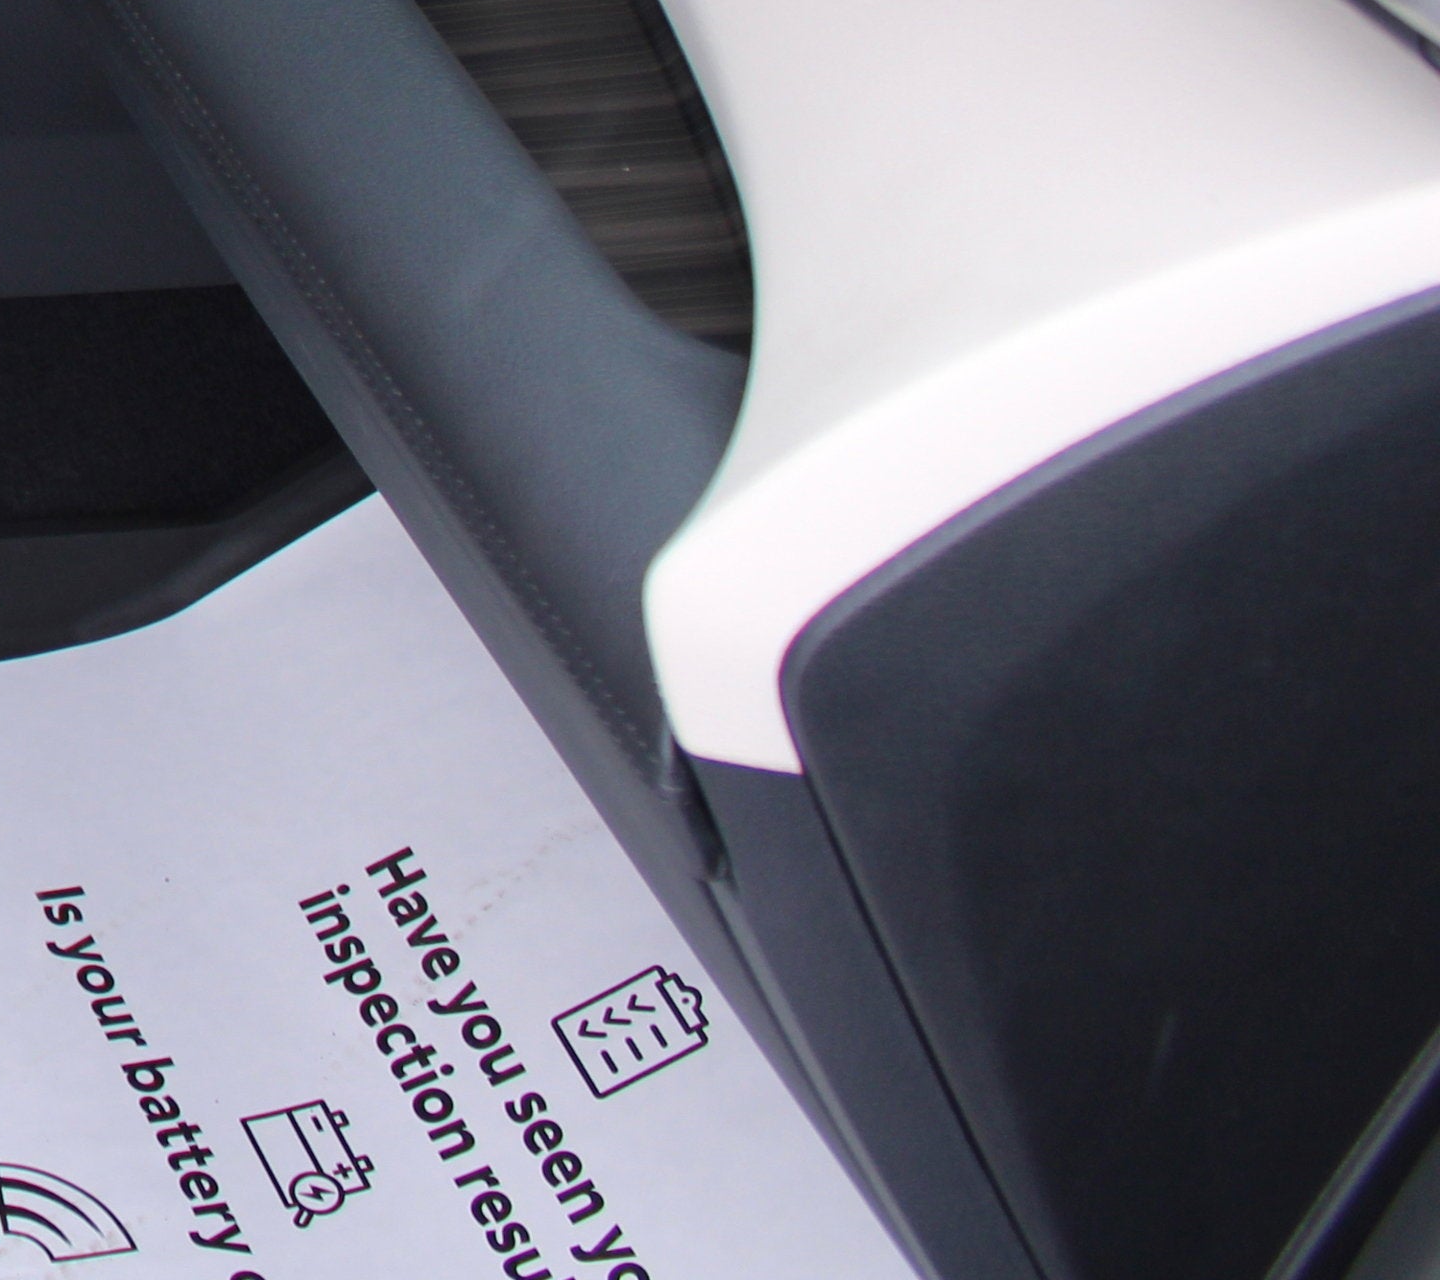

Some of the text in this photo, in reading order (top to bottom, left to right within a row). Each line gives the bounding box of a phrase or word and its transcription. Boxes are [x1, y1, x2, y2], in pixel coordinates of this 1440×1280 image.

[35, 884, 253, 1254] Is your battery
[298, 883, 576, 1280] inspection resu
[365, 845, 461, 981] Have
[427, 981, 526, 1087] you
[504, 1091, 605, 1225] seen
